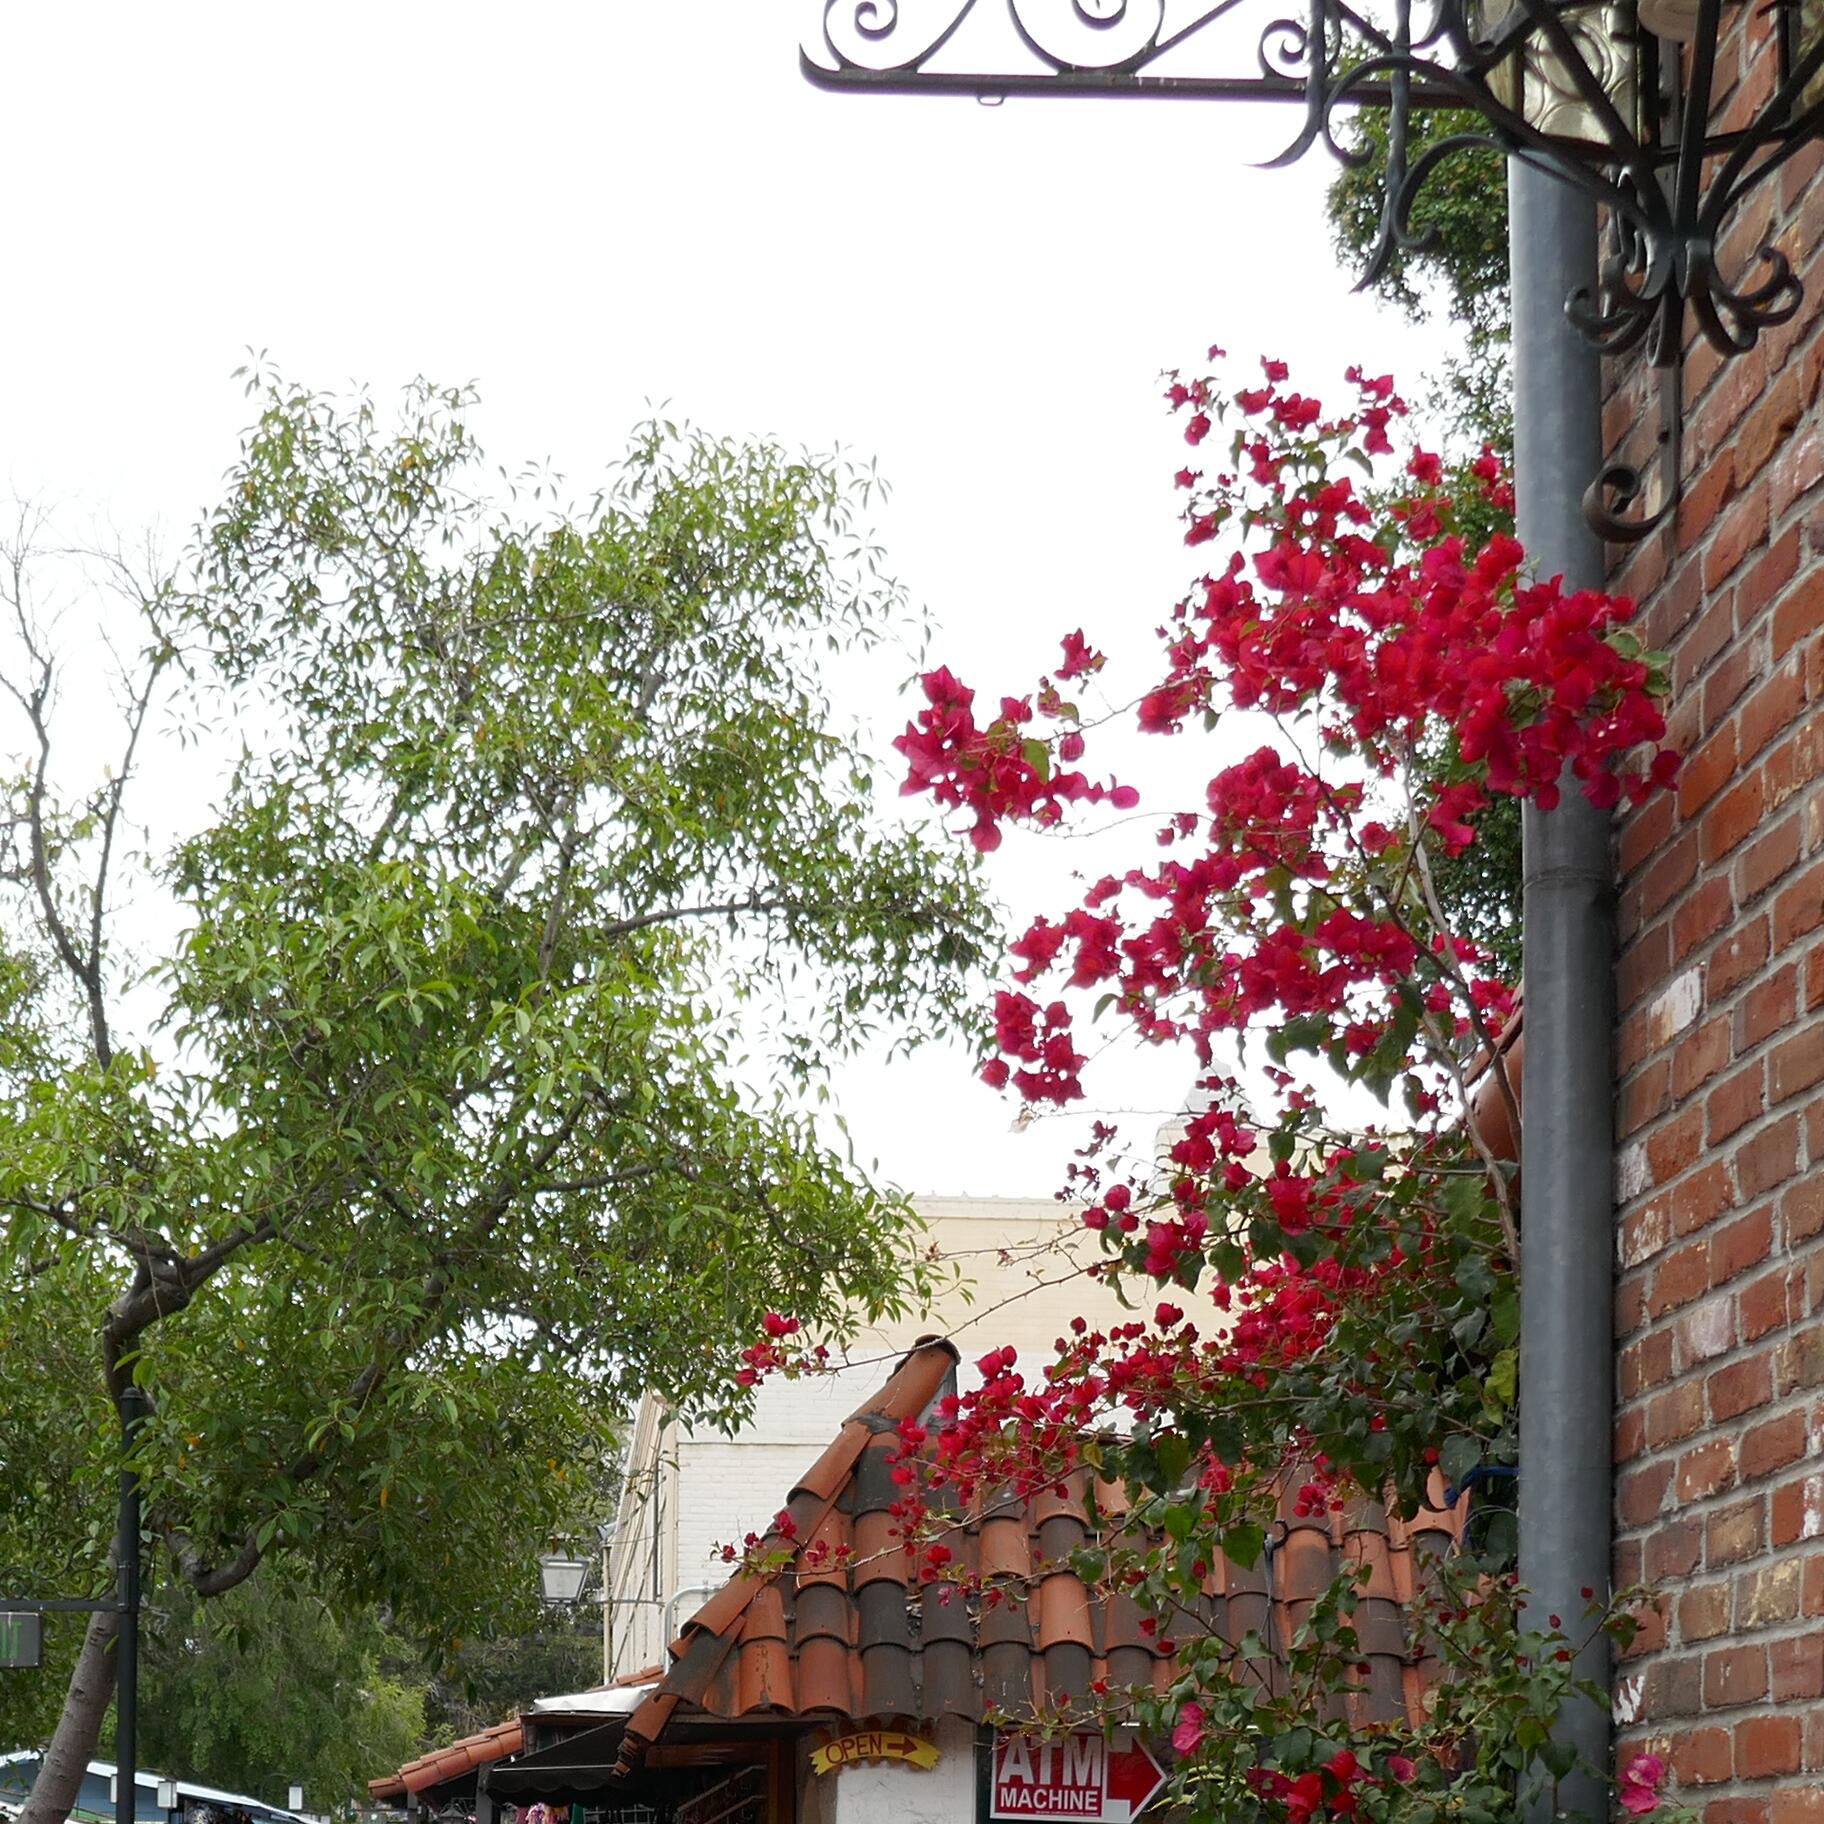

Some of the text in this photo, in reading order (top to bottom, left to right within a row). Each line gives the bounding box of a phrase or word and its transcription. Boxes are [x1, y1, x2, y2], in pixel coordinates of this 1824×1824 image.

[825, 1733, 883, 1764] OPEN
[998, 1734, 1102, 1787] ATM
[1000, 1787, 1098, 1811] MACHINE
